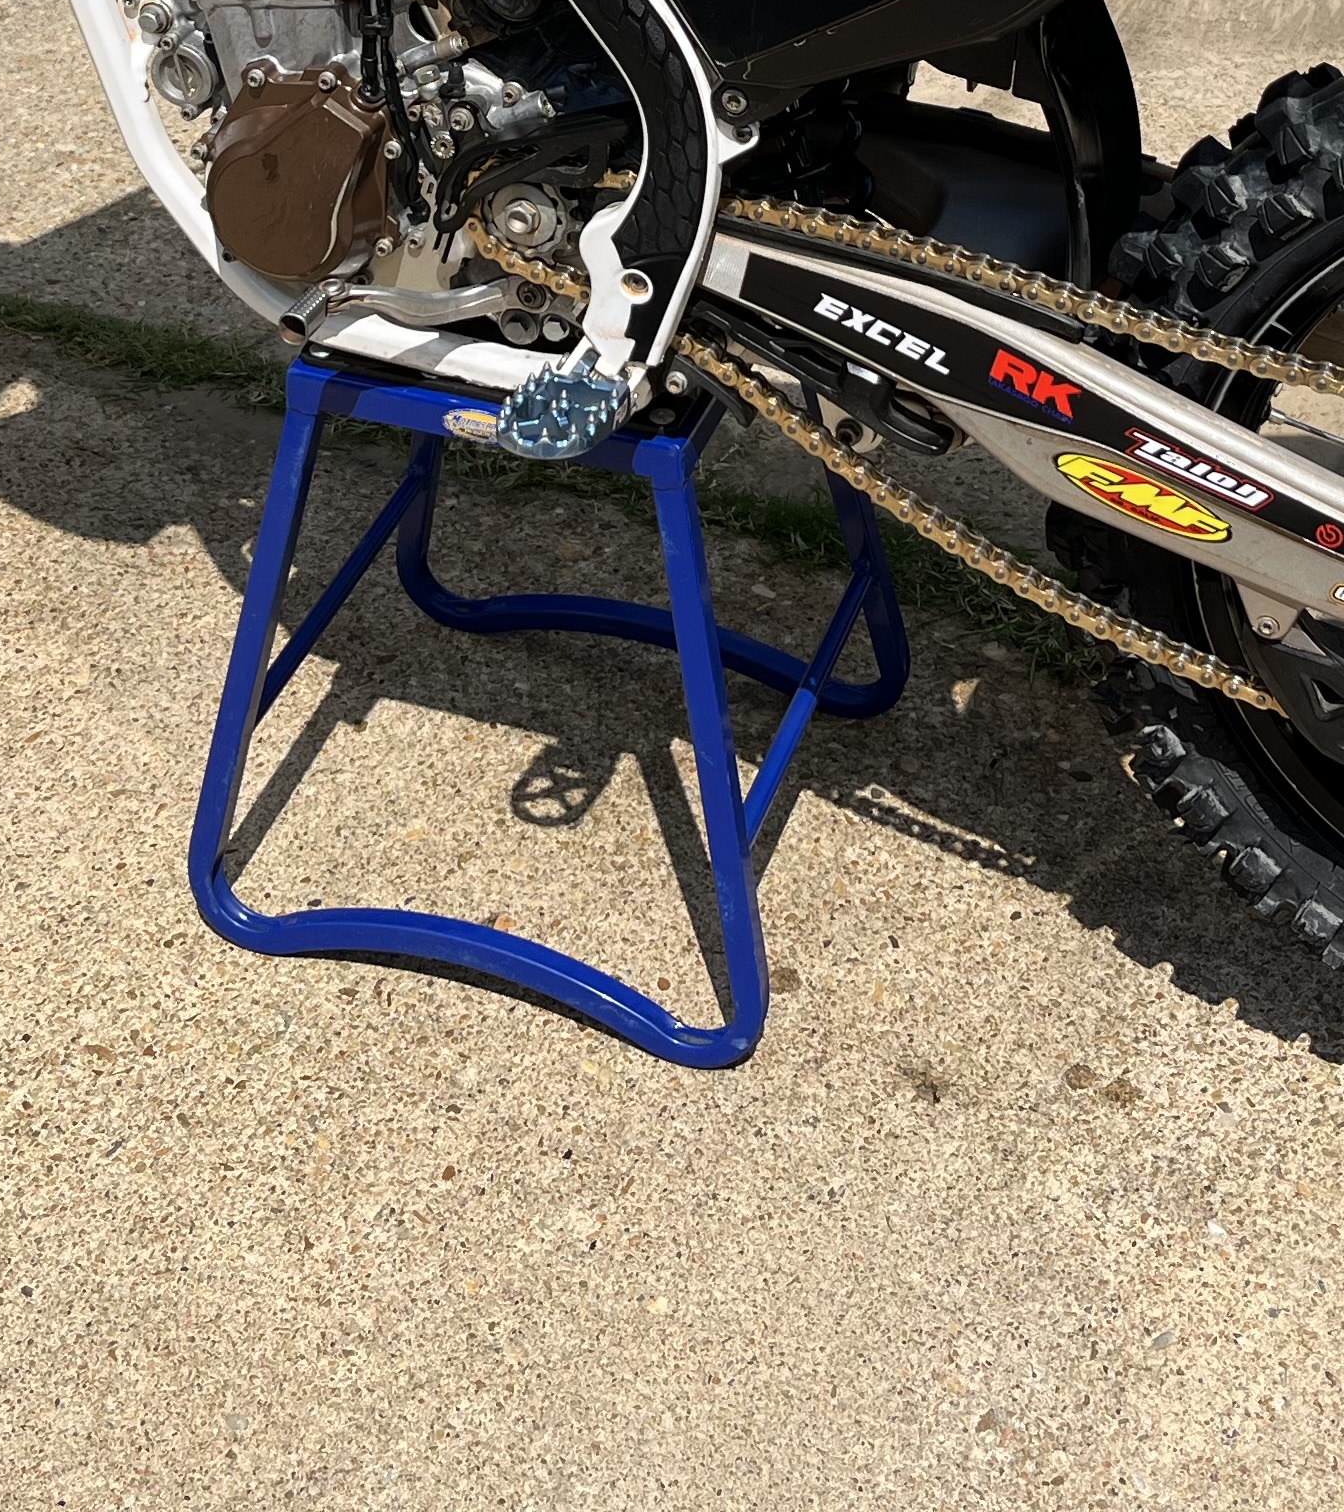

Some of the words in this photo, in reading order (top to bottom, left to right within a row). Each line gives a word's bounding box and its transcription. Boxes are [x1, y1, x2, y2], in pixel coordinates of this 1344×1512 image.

[813, 293, 951, 376] EXCEL
[989, 349, 1082, 419] RK
[1058, 457, 1231, 533] FMF
[1134, 432, 1270, 502] Talon
